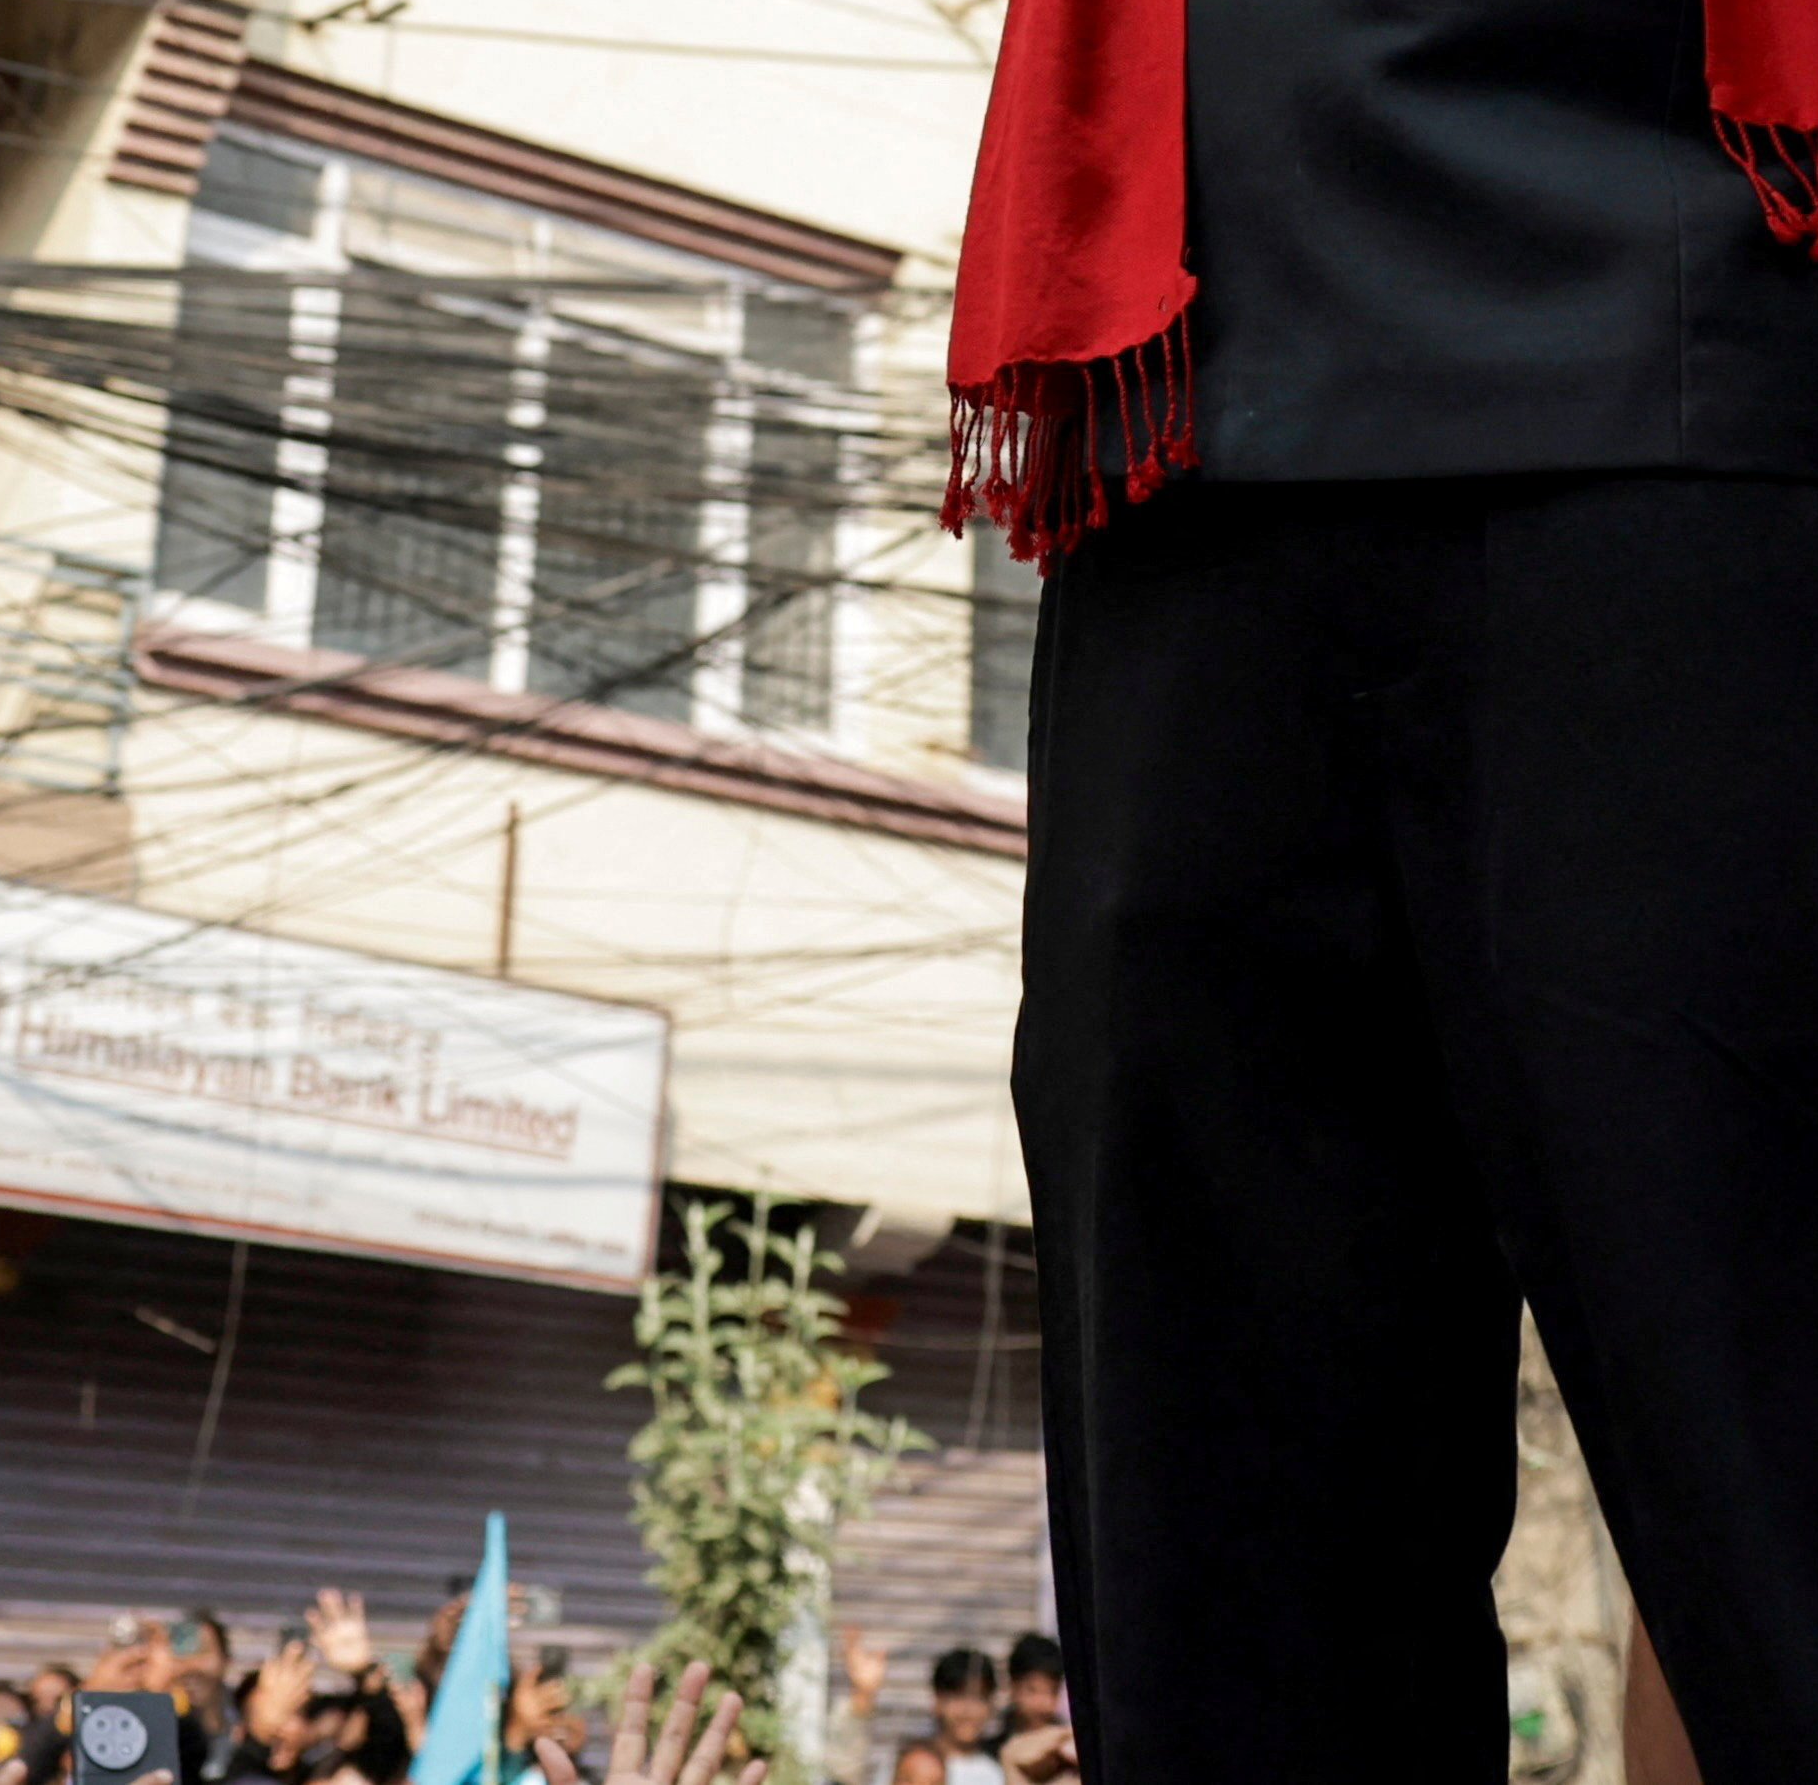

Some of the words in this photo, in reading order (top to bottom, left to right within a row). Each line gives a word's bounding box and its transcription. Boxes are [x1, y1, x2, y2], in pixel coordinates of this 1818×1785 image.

[15, 1010, 272, 1095] Himalayan
[288, 1053, 403, 1115] Bank
[419, 1081, 579, 1147] Limited
